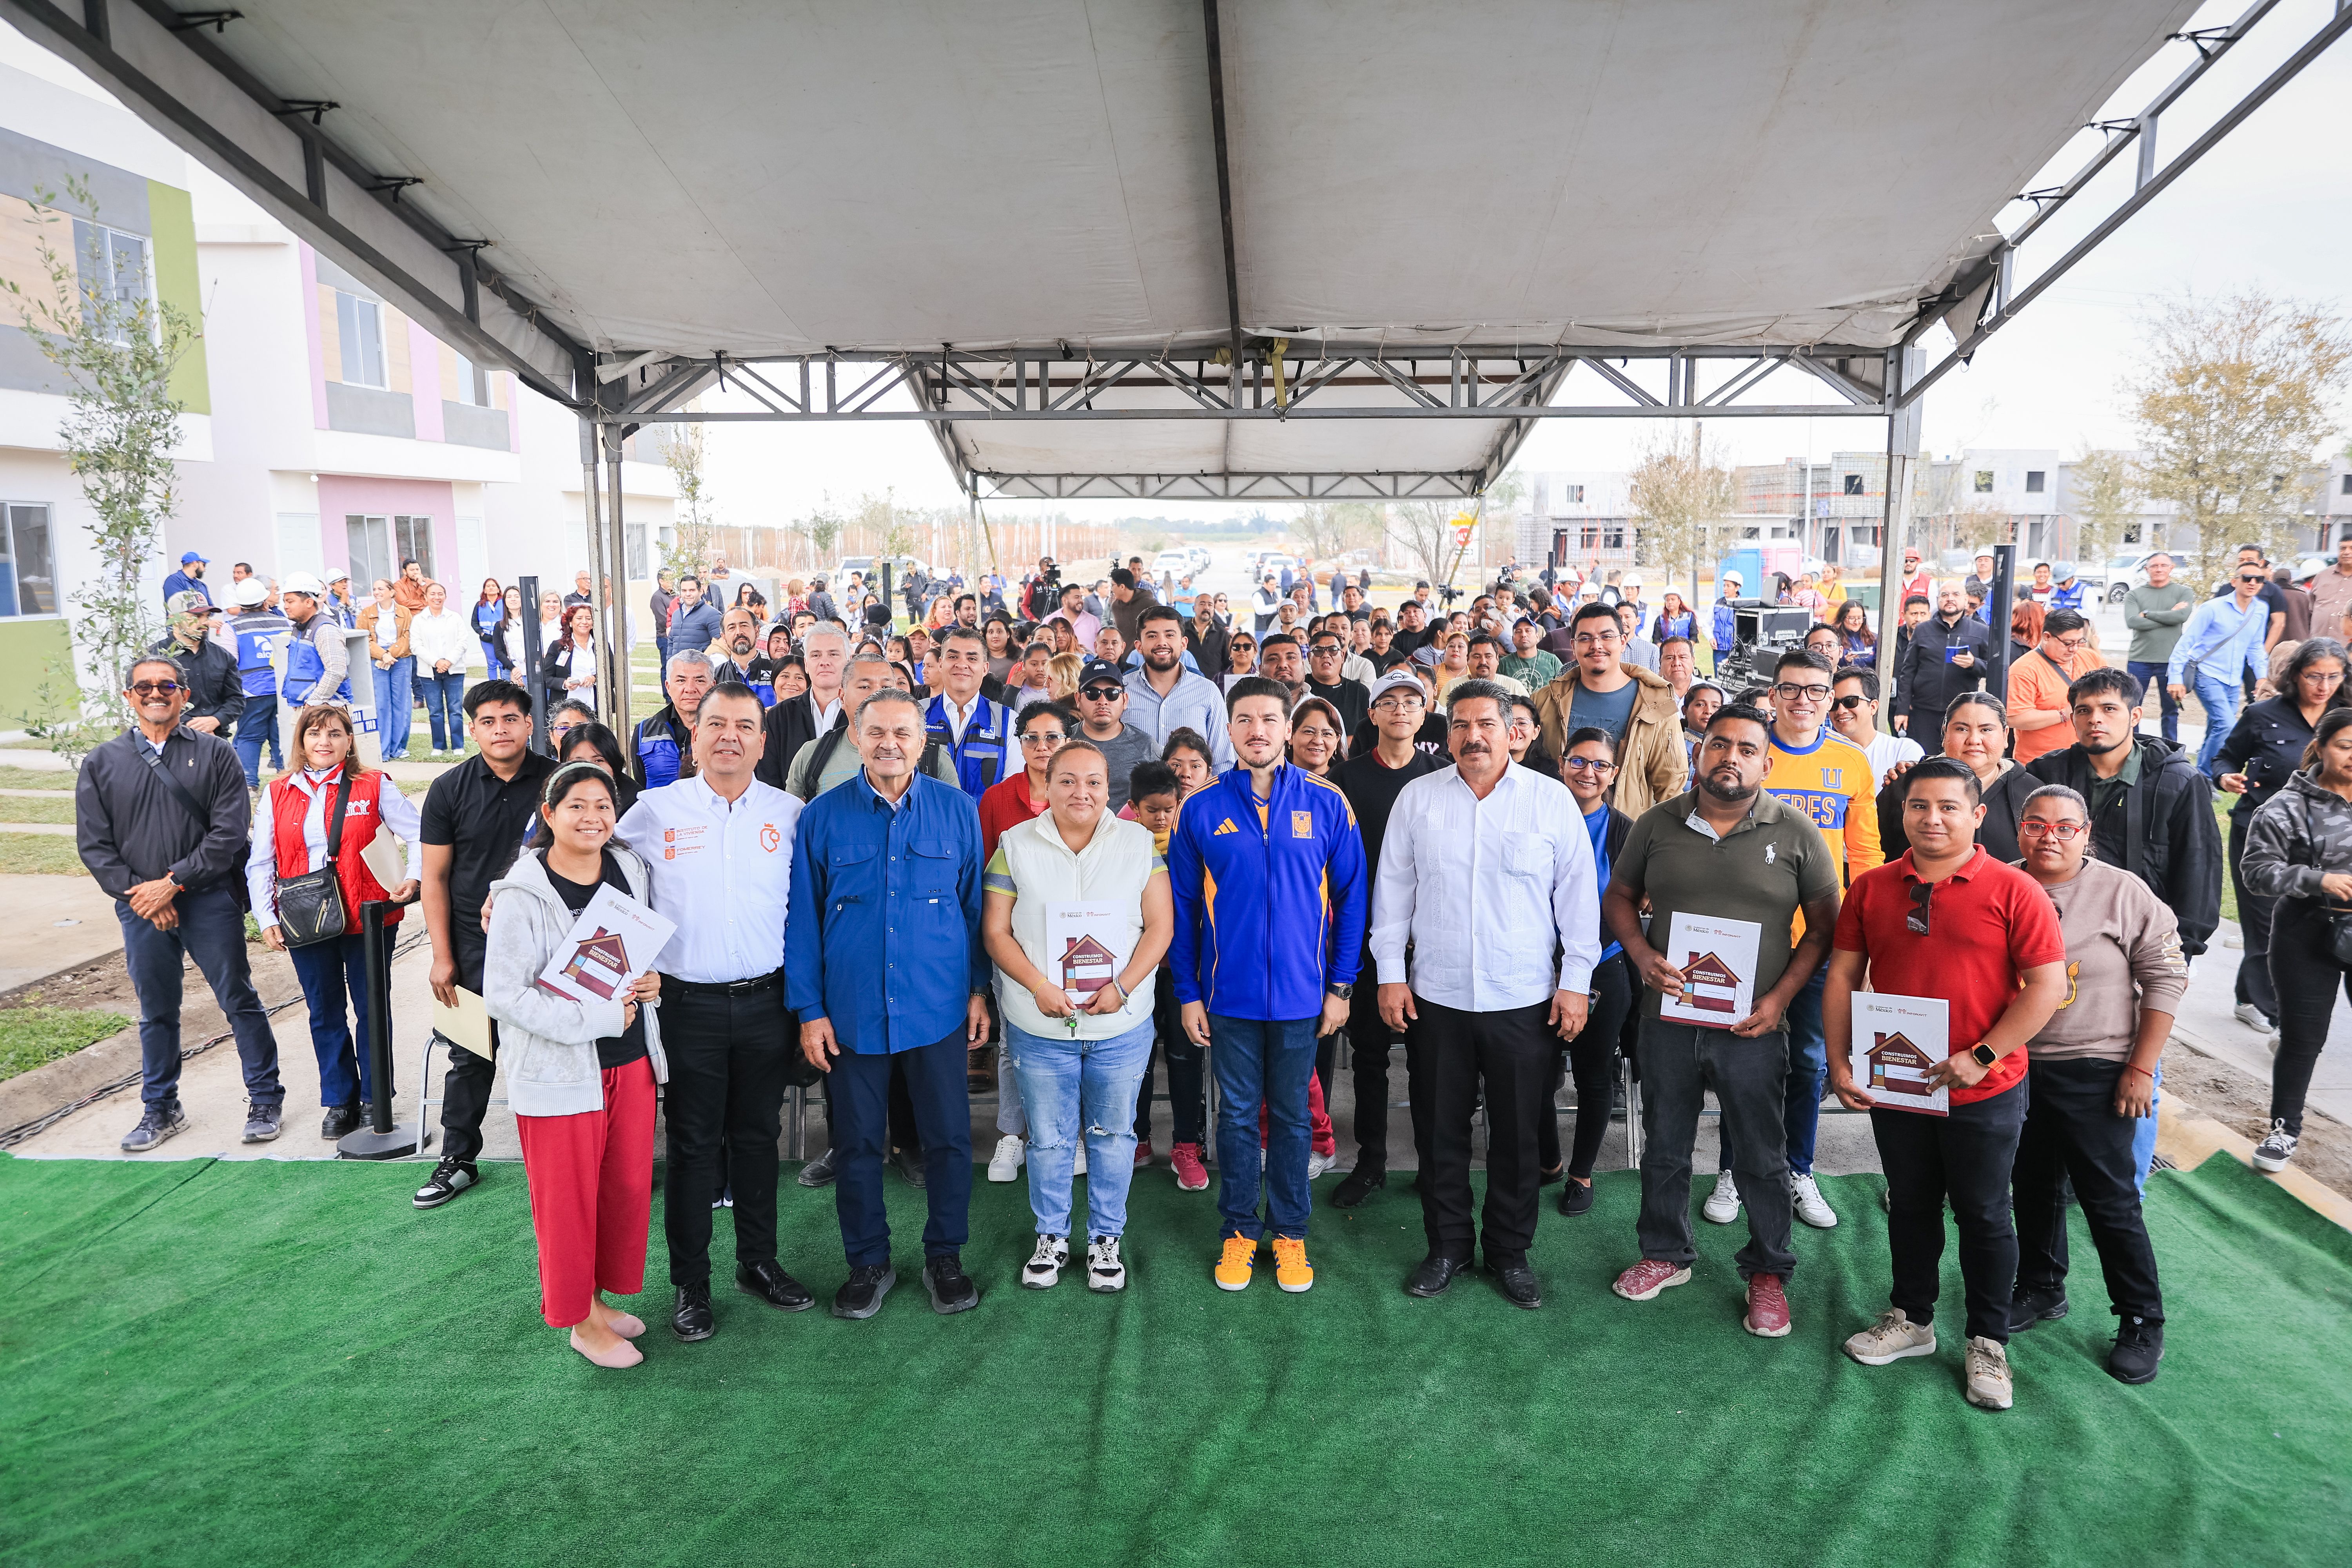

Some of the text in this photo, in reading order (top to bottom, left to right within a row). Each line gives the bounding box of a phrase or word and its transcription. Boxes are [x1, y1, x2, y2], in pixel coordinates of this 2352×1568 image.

[1820, 768, 1842, 789] U
[1771, 794, 1837, 825] RES
[614, 905, 655, 931] México INFONAVIT
[588, 949, 618, 969] BIENESTAR
[592, 945, 621, 964] CONSTRUIMOS
[1692, 974, 1725, 984] BIENESTAR
[1693, 970, 1726, 978] CONSTRUIMOS
[1881, 1055, 1917, 1065] BIENESTAR
